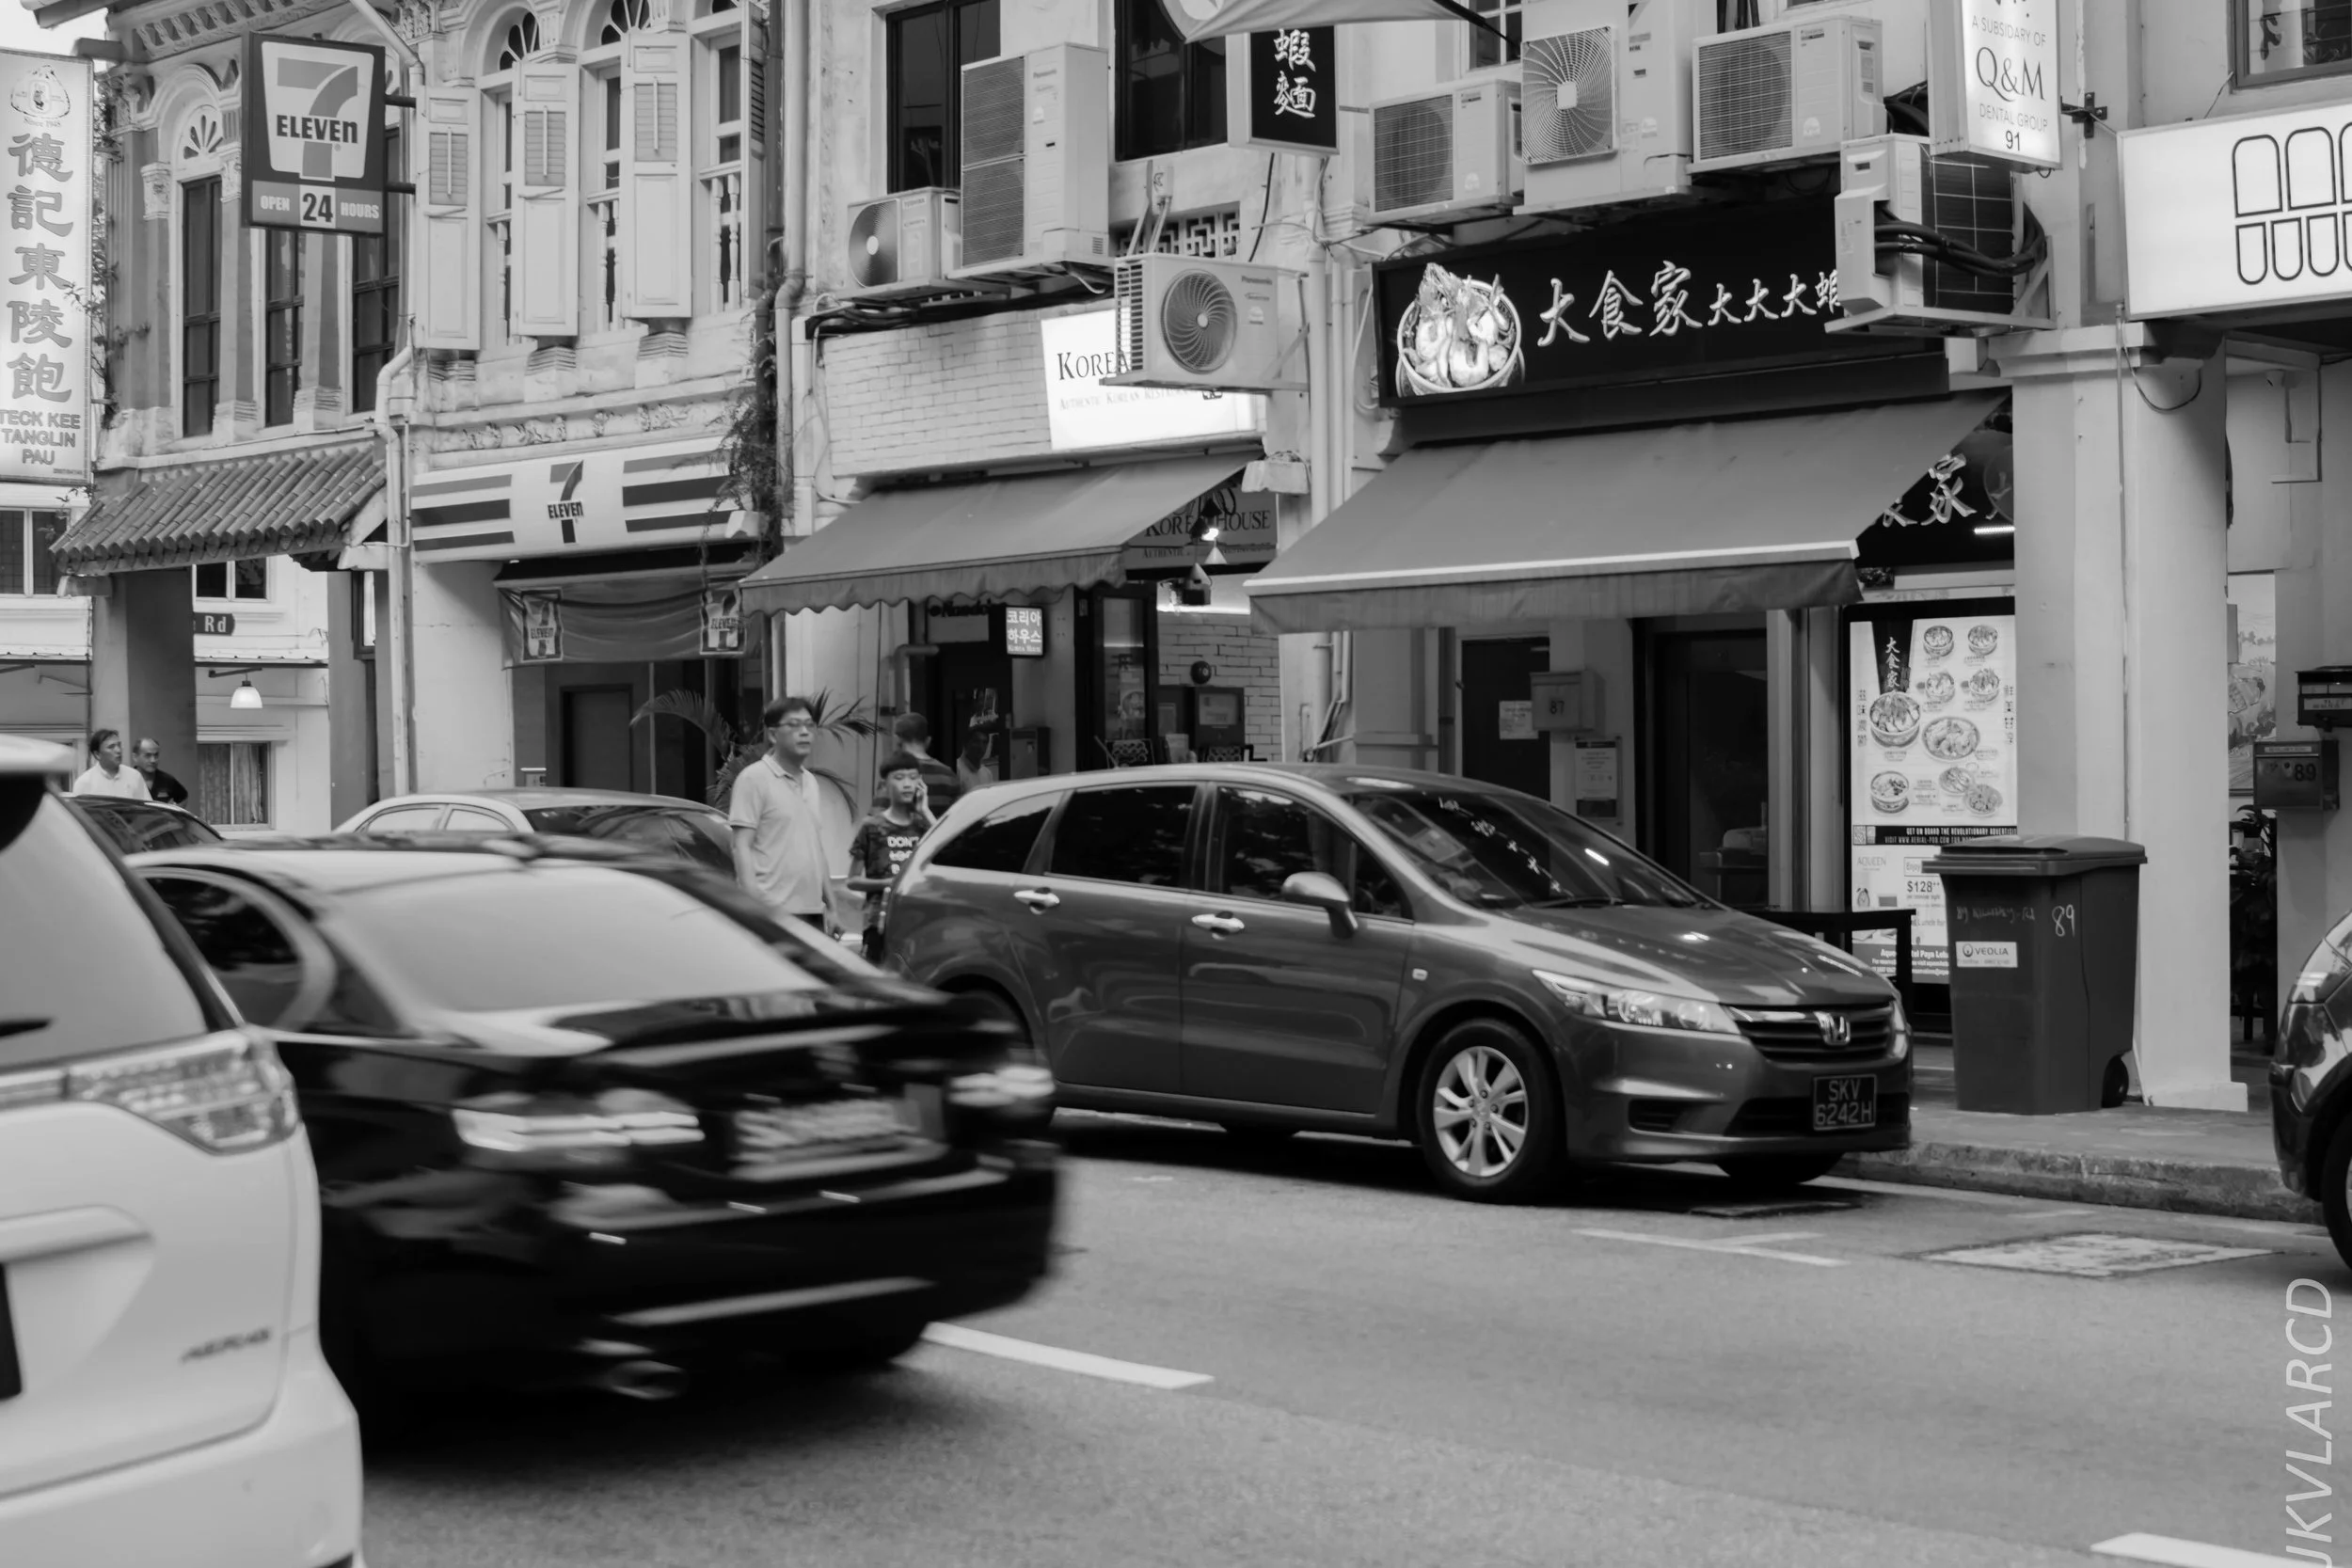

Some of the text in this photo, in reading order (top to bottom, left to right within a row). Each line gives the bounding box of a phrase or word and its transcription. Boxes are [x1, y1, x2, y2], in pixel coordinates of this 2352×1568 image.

[1972, 15, 1979, 29] A
[2033, 31, 2046, 47] OF
[1976, 46, 2047, 103] Q&M
[1979, 103, 2048, 134] DENTAL GROUP
[2005, 130, 2021, 151] 91
[260, 192, 380, 224] OPEN 24 HOURS
[48, 412, 82, 430] KEE
[1, 428, 76, 448] TANGLIN
[22, 448, 56, 466] PAU
[204, 614, 228, 634] Rd
[1007, 610, 1042, 626] 코리아
[1007, 627, 1042, 644] 하우스
[2294, 762, 2317, 782] 89
[1941, 827, 1949, 836] THE
[2051, 903, 2075, 938] 89
[1974, 946, 2010, 956] VEOLIA
[1828, 1078, 1861, 1102] SKV
[1815, 1101, 1873, 1126] 6242H
